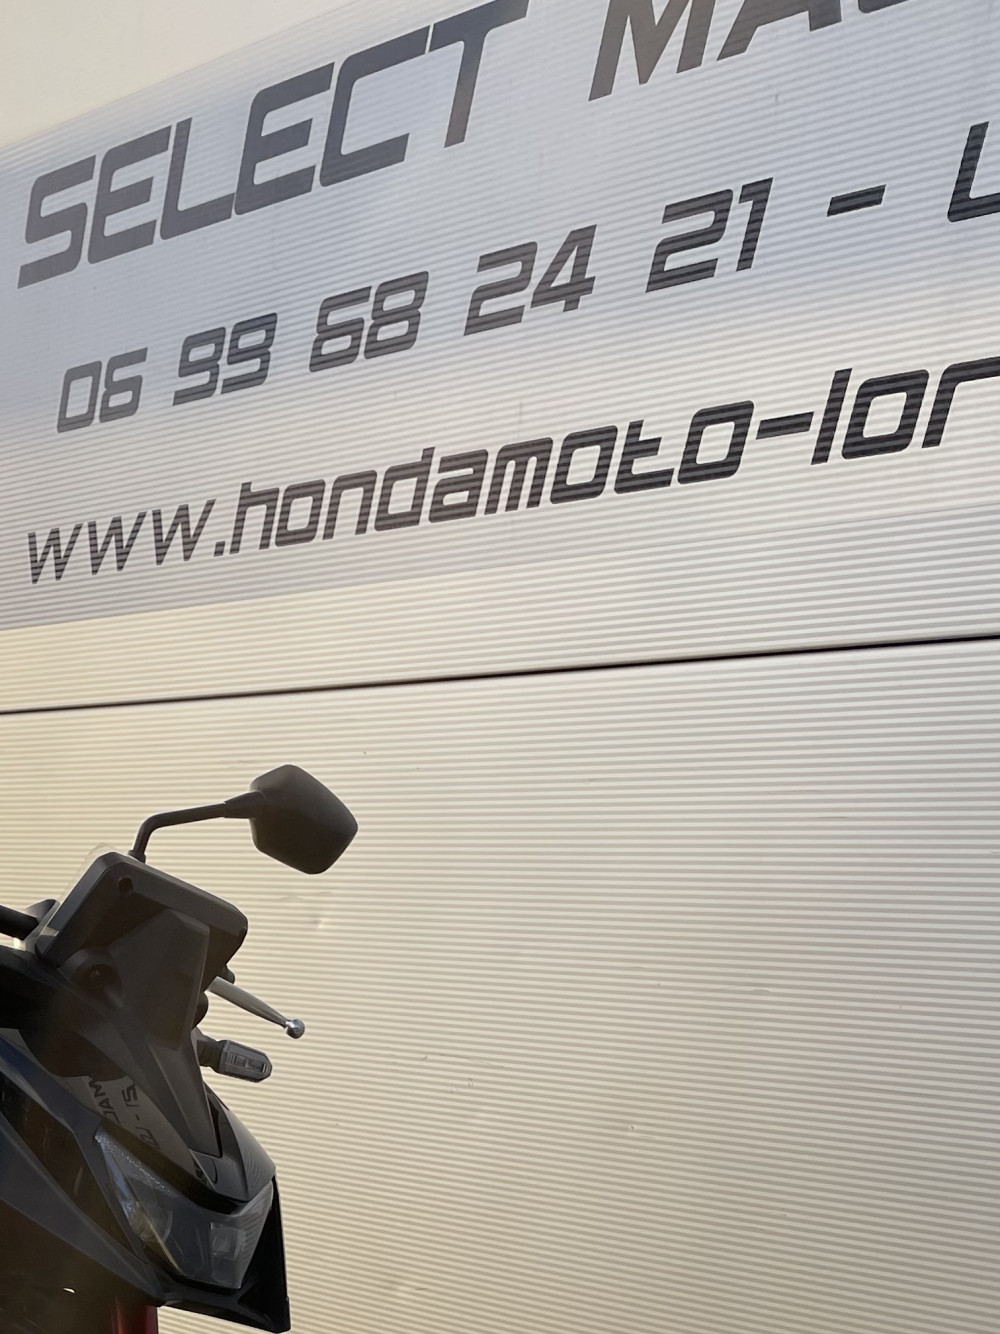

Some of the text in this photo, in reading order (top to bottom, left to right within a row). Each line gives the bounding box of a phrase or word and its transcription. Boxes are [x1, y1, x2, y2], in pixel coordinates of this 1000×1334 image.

[18, 0, 527, 288] SELECT
[57, 347, 148, 433] 06
[172, 313, 277, 406] 99
[309, 271, 429, 372] 68
[464, 224, 597, 336] 24
[645, 177, 773, 293] 21
[826, 184, 886, 217] -
